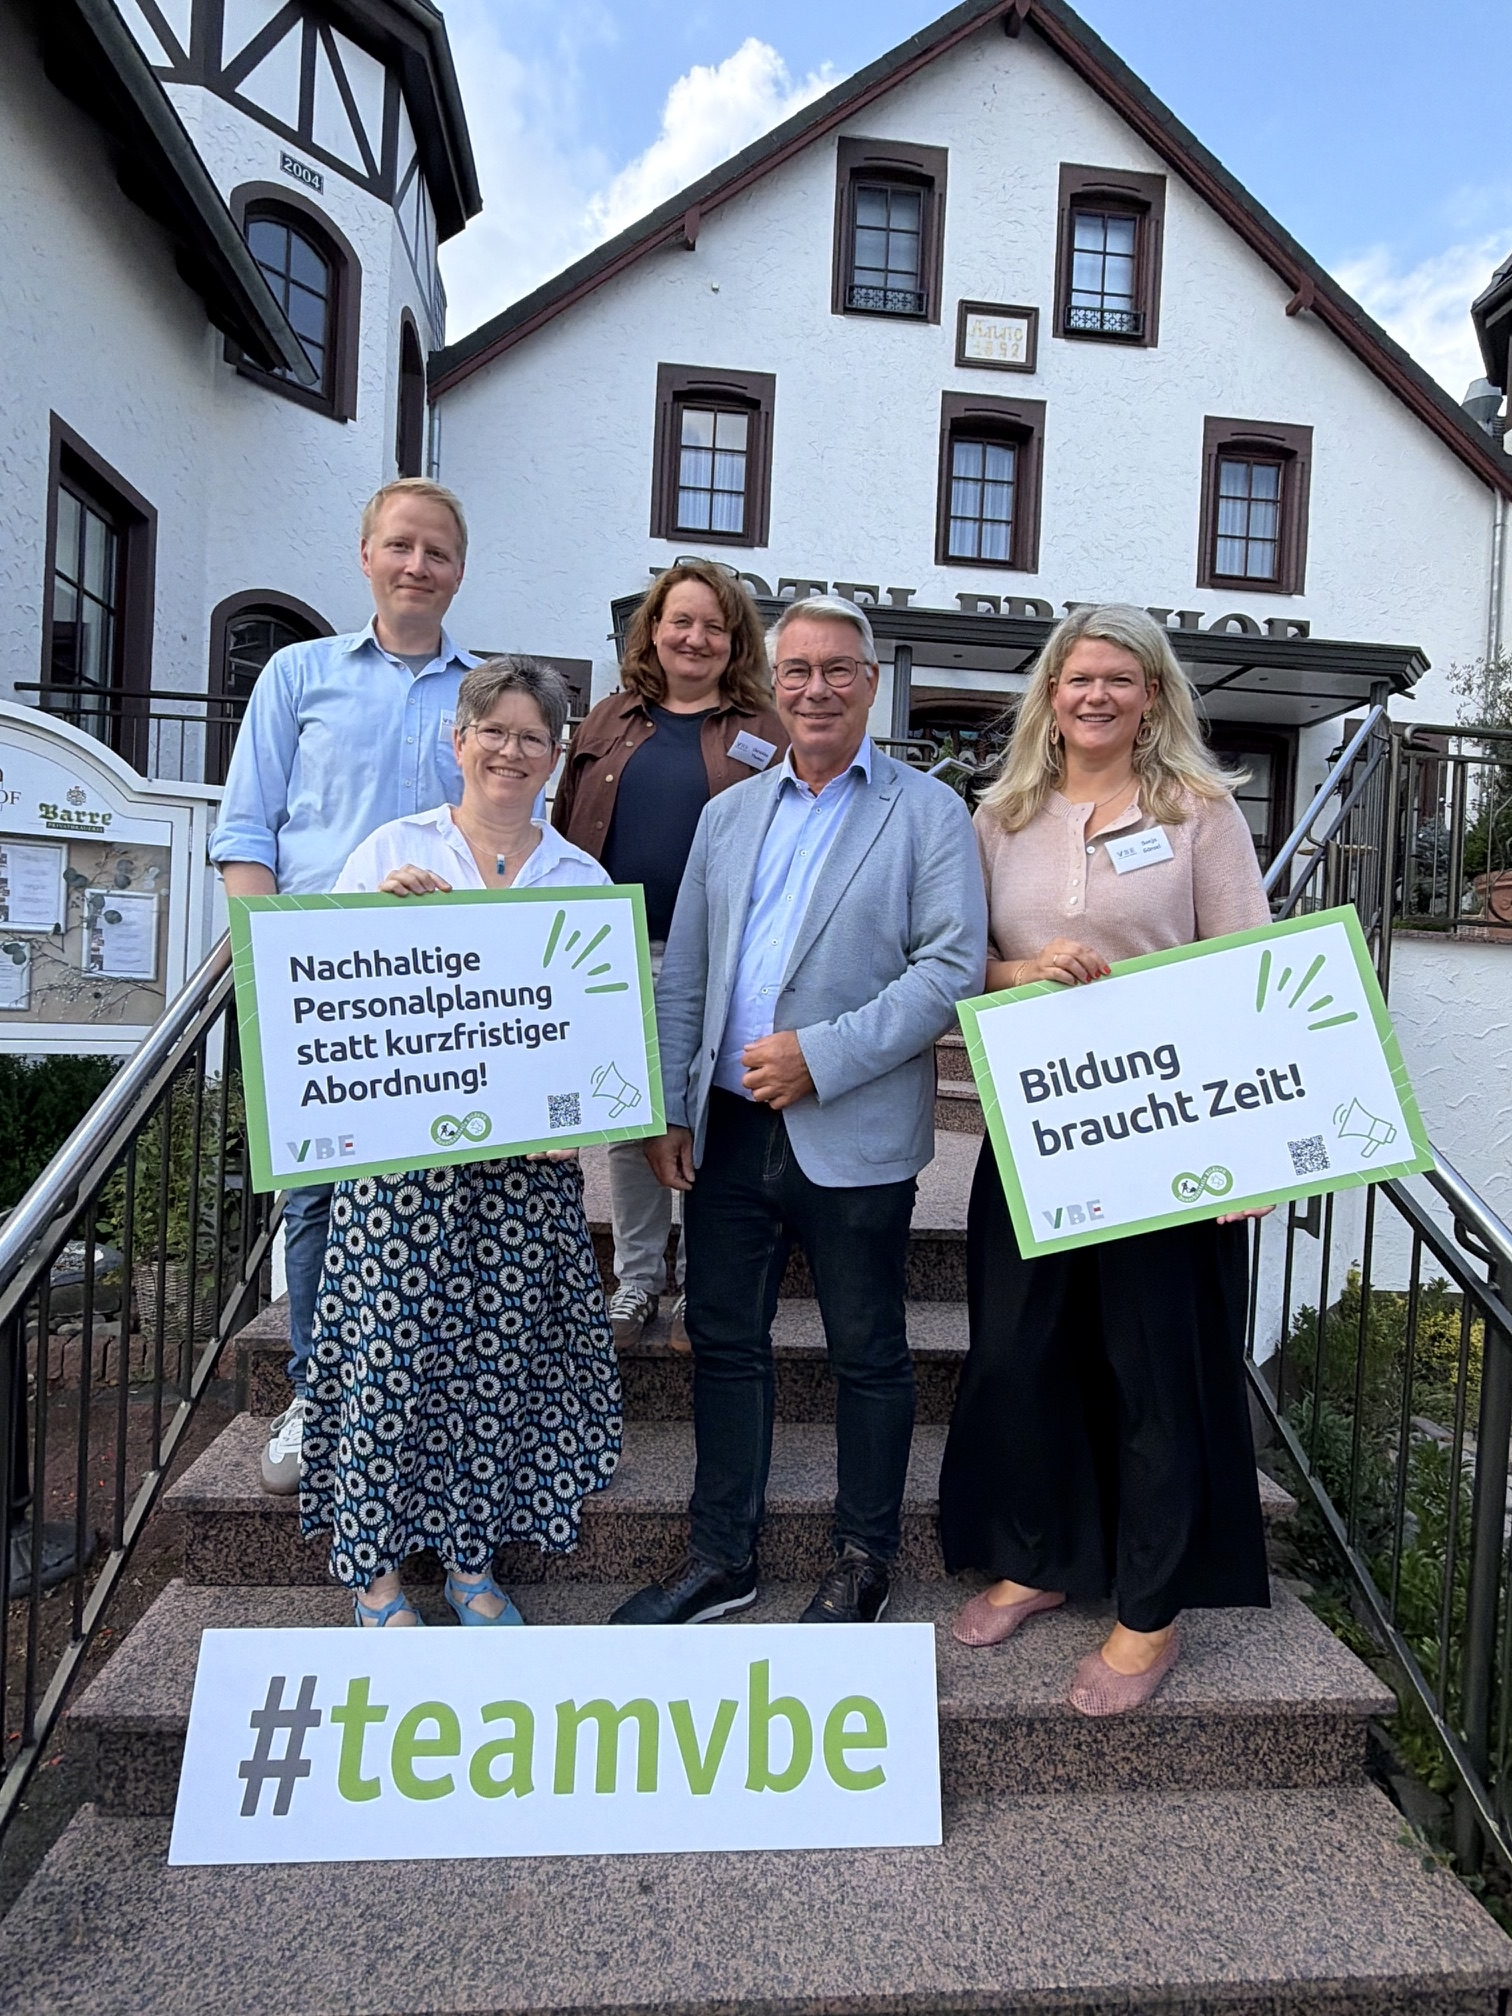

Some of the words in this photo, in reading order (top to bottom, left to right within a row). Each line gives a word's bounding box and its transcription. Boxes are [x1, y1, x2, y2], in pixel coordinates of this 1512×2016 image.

[284, 157, 321, 188] 2004
[969, 319, 1023, 341] Anno
[38, 802, 113, 826] Barre
[289, 946, 481, 983] Nachhaltige
[293, 984, 552, 1024] Personalplanung
[297, 1033, 379, 1066] statt
[385, 1018, 571, 1057] kurzfristiger
[300, 1062, 488, 1107] Abordnung!
[1019, 1044, 1180, 1104] Bildung
[1031, 1091, 1200, 1157] braucht
[1202, 1063, 1306, 1118] Zeit!
[286, 1134, 356, 1163] VBE
[1041, 1198, 1105, 1230] VBE
[238, 1659, 888, 1817] #teamvbe
